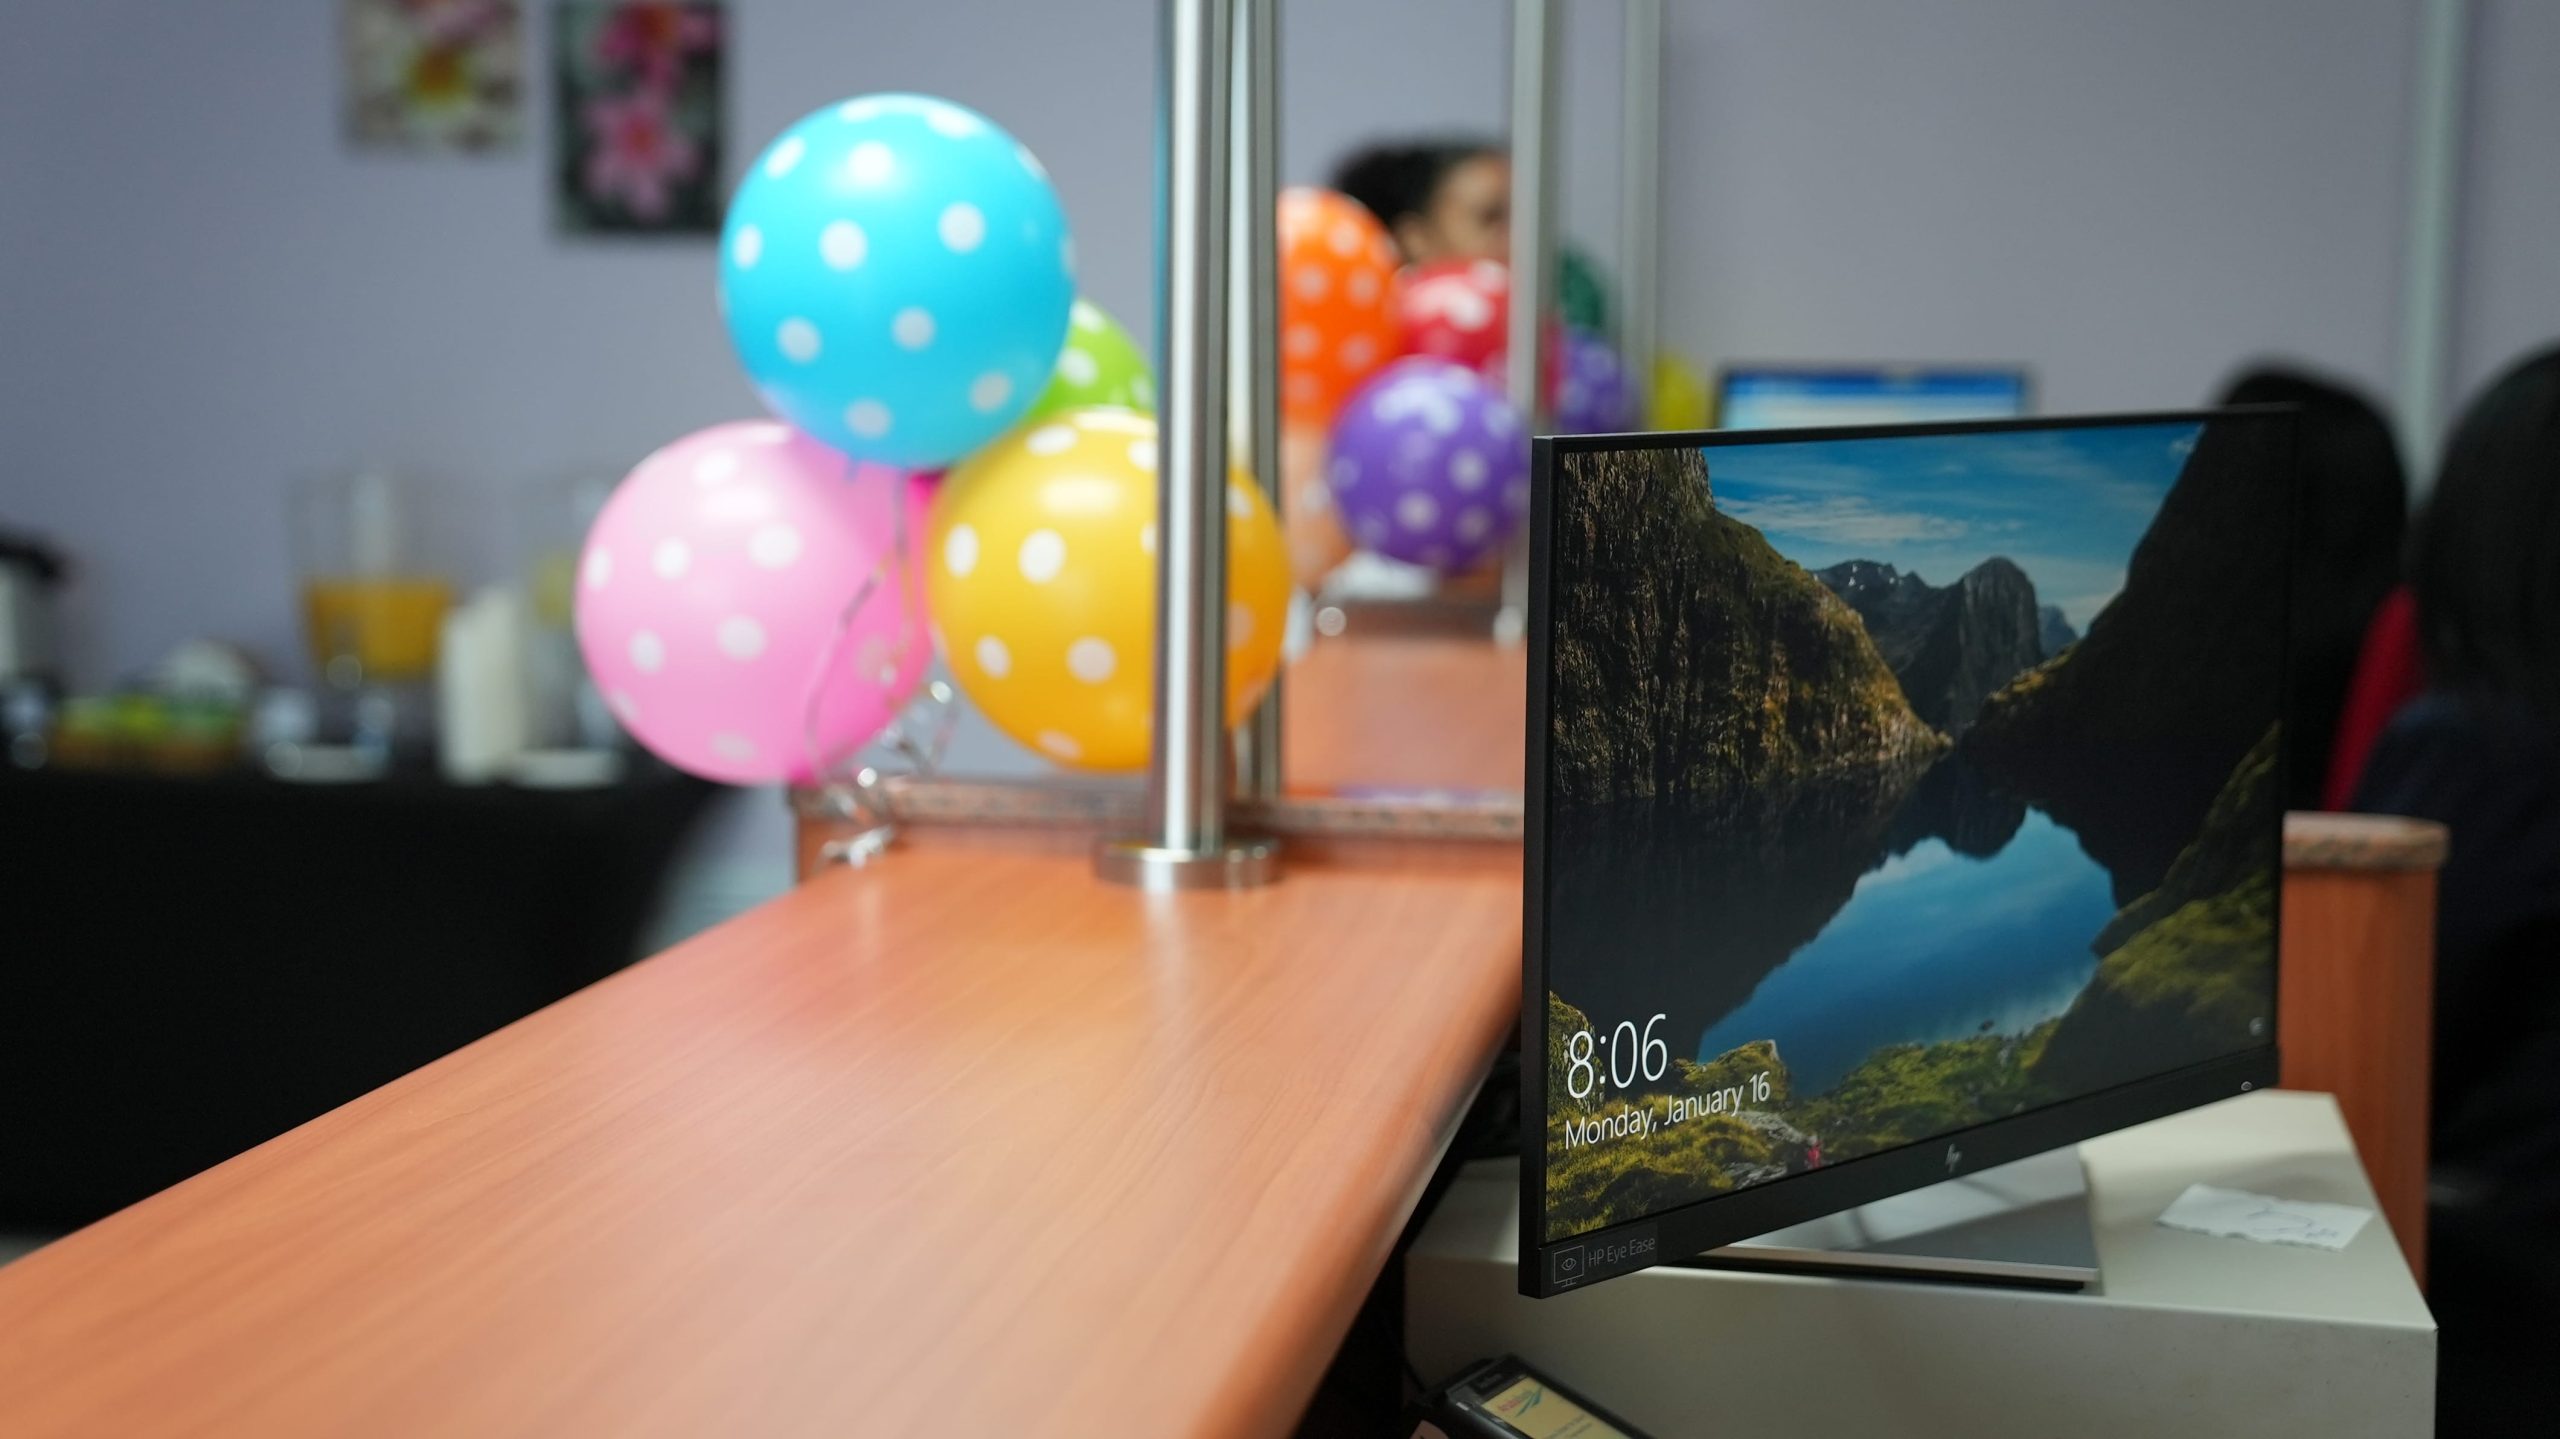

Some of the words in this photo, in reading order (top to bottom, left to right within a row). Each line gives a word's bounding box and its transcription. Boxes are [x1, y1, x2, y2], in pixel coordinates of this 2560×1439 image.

[1567, 1013, 1668, 1099] 8:06
[1564, 1104, 1657, 1150] Monday,
[1664, 1085, 1744, 1126] January
[1749, 1071, 1771, 1103] 16
[1588, 1248, 1605, 1267] HP
[1606, 1245, 1627, 1264] Eye
[1629, 1237, 1656, 1256] Ease
